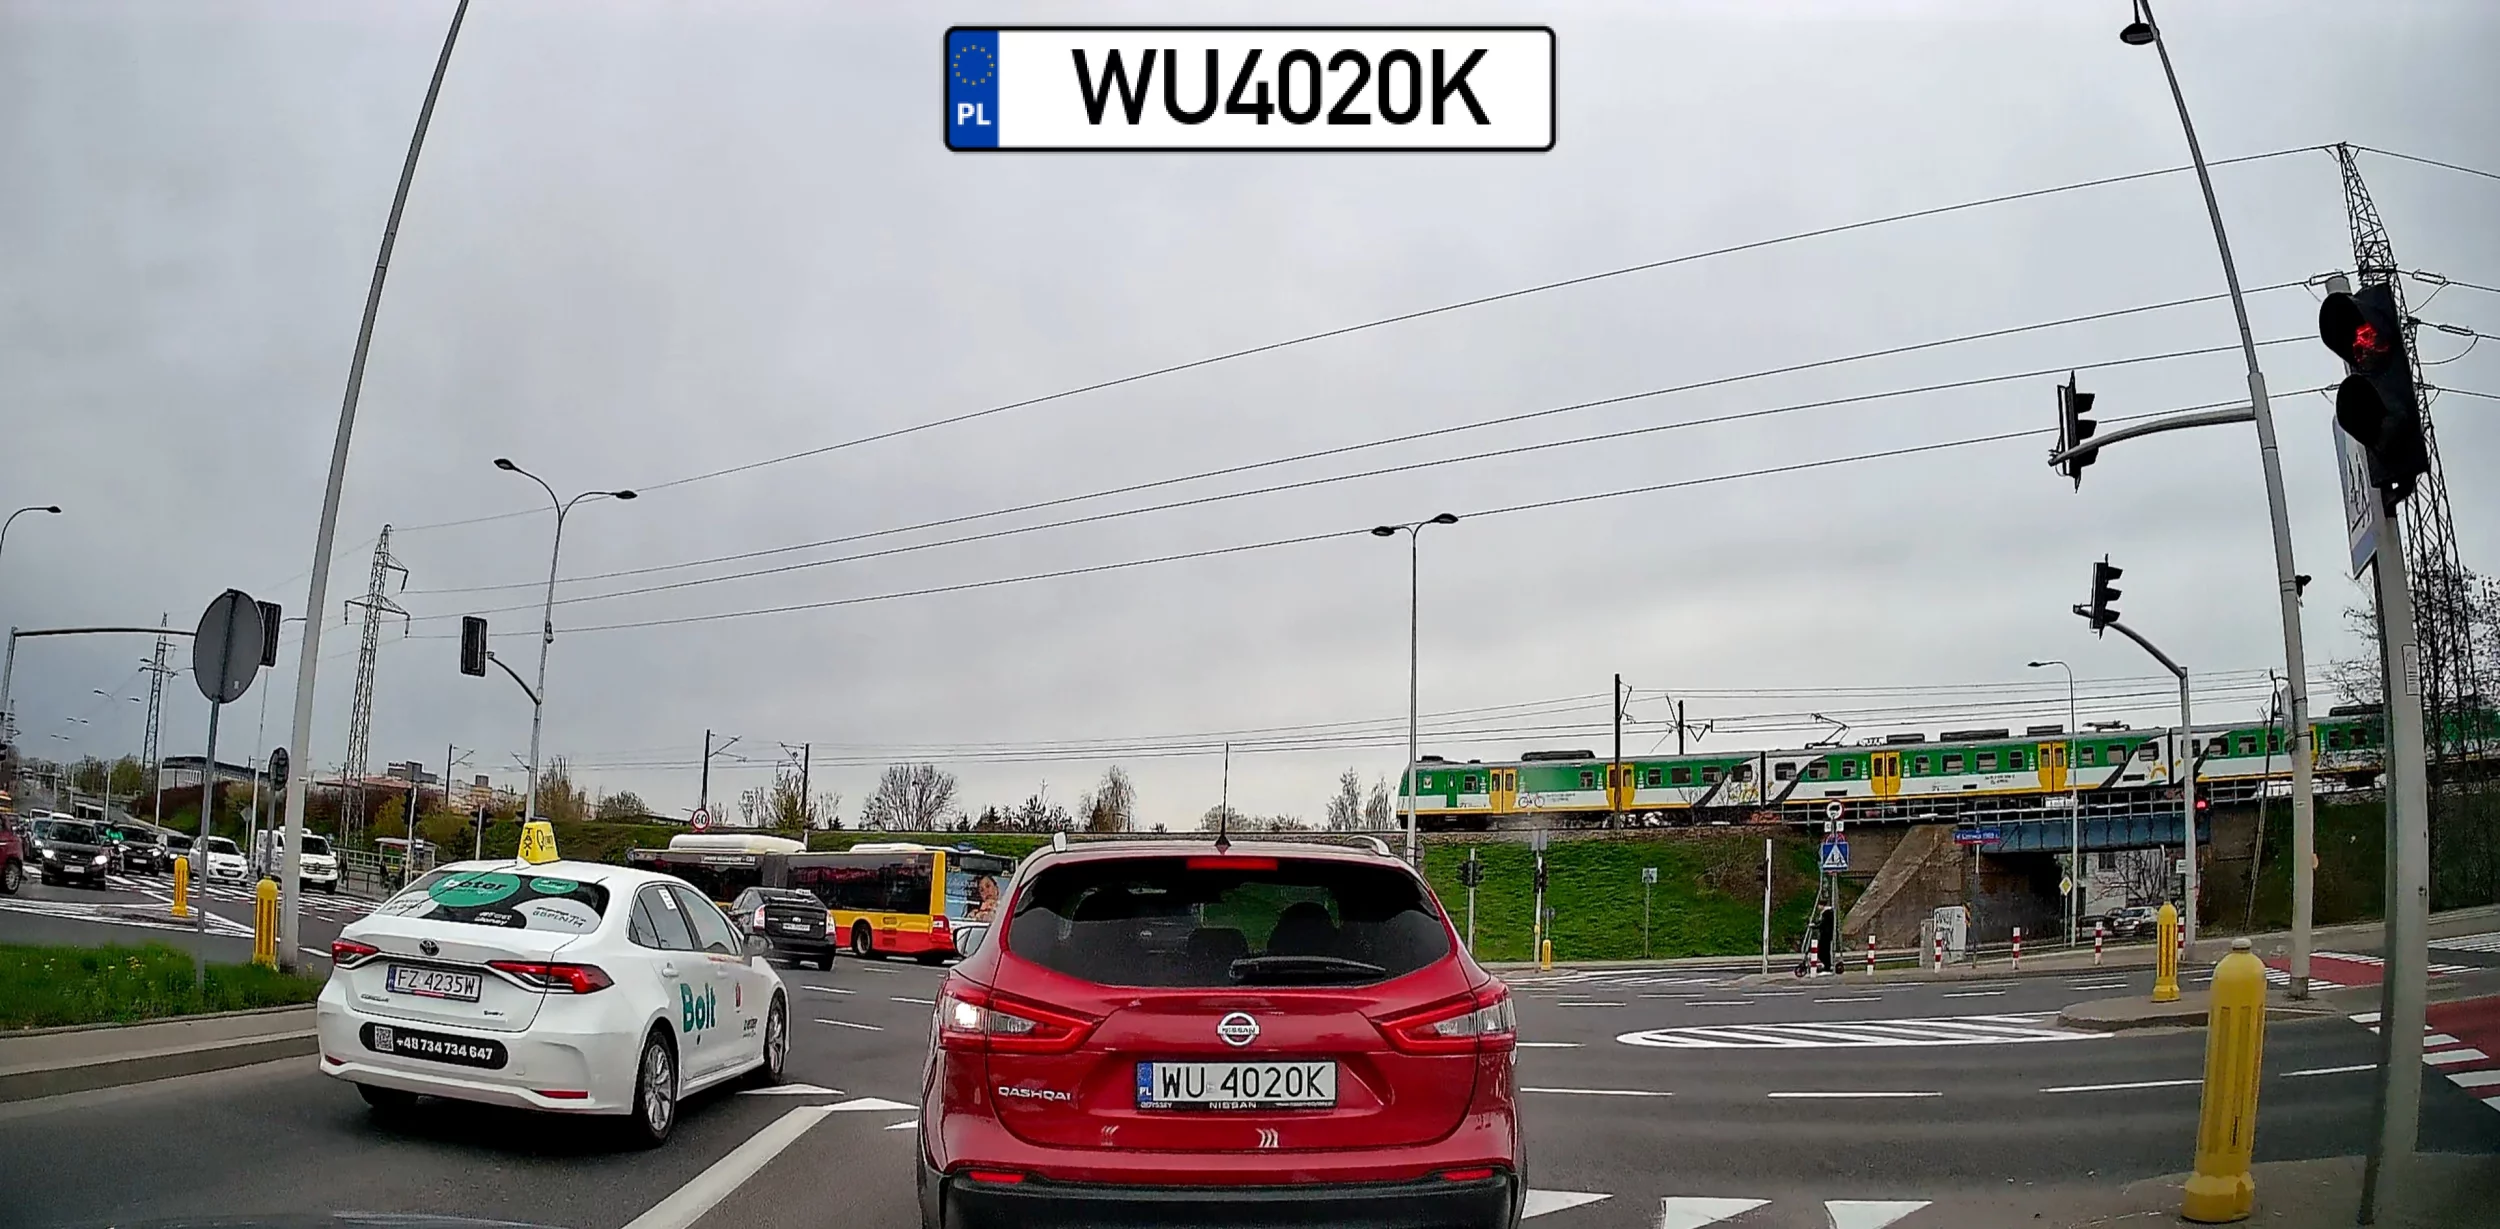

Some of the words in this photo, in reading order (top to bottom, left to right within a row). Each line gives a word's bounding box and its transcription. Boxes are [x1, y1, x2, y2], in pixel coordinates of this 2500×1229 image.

[695, 813, 707, 825] 60
[524, 826, 534, 857] TAXI
[397, 969, 418, 989] FZ
[424, 973, 476, 996] 4235W
[680, 982, 716, 1034] Bolt
[396, 1035, 419, 1050] +48
[420, 1038, 443, 1053] 734
[443, 1041, 468, 1057] 734
[469, 1045, 493, 1061] 647
[998, 1086, 1071, 1101] QASHQAI
[1139, 1087, 1152, 1096] PL
[1161, 1065, 1205, 1099] WU
[1219, 1065, 1327, 1099] 4020K
[1209, 1101, 1257, 1109] NISSAN
